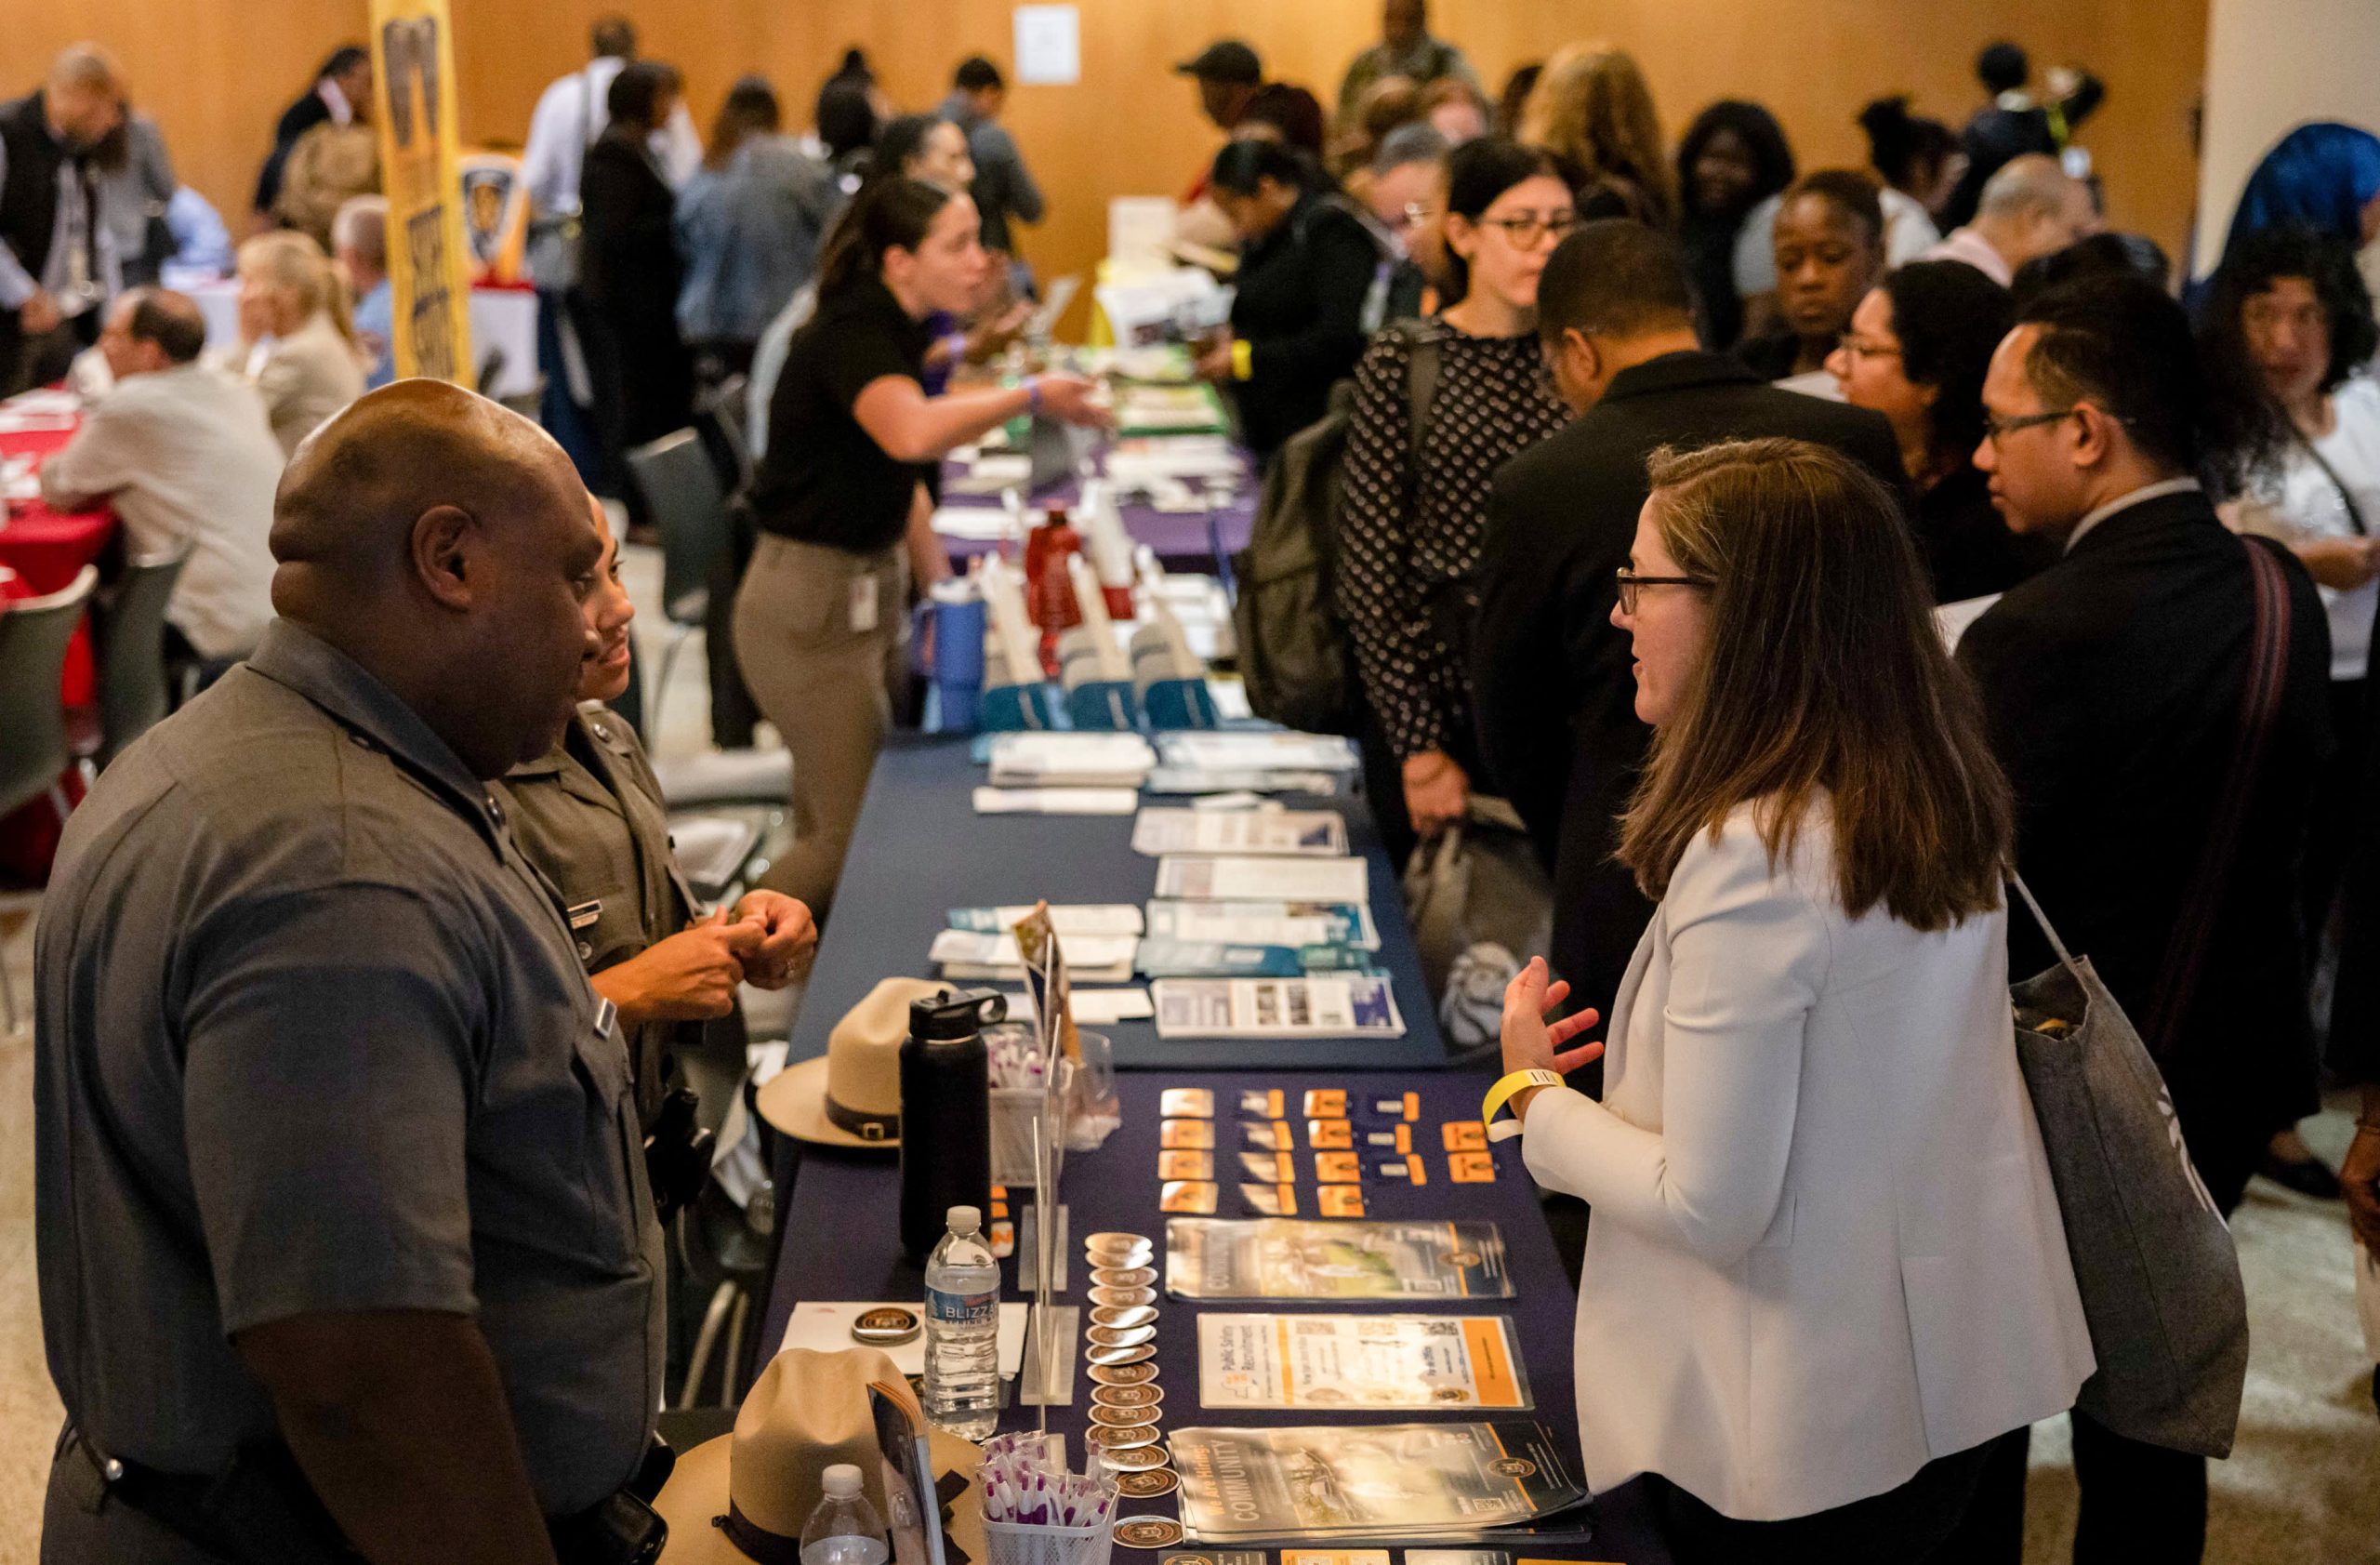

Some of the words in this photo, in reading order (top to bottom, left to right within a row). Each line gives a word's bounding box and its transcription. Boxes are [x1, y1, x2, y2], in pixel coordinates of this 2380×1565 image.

[1220, 1349, 1236, 1371] Public
[1240, 1326, 1255, 1371] Recruitment
[1189, 1444, 1214, 1478] Hiring!
[1204, 1480, 1221, 1498] Are
[1210, 1439, 1260, 1522] COMMUNITY
[1206, 1501, 1225, 1516] We
